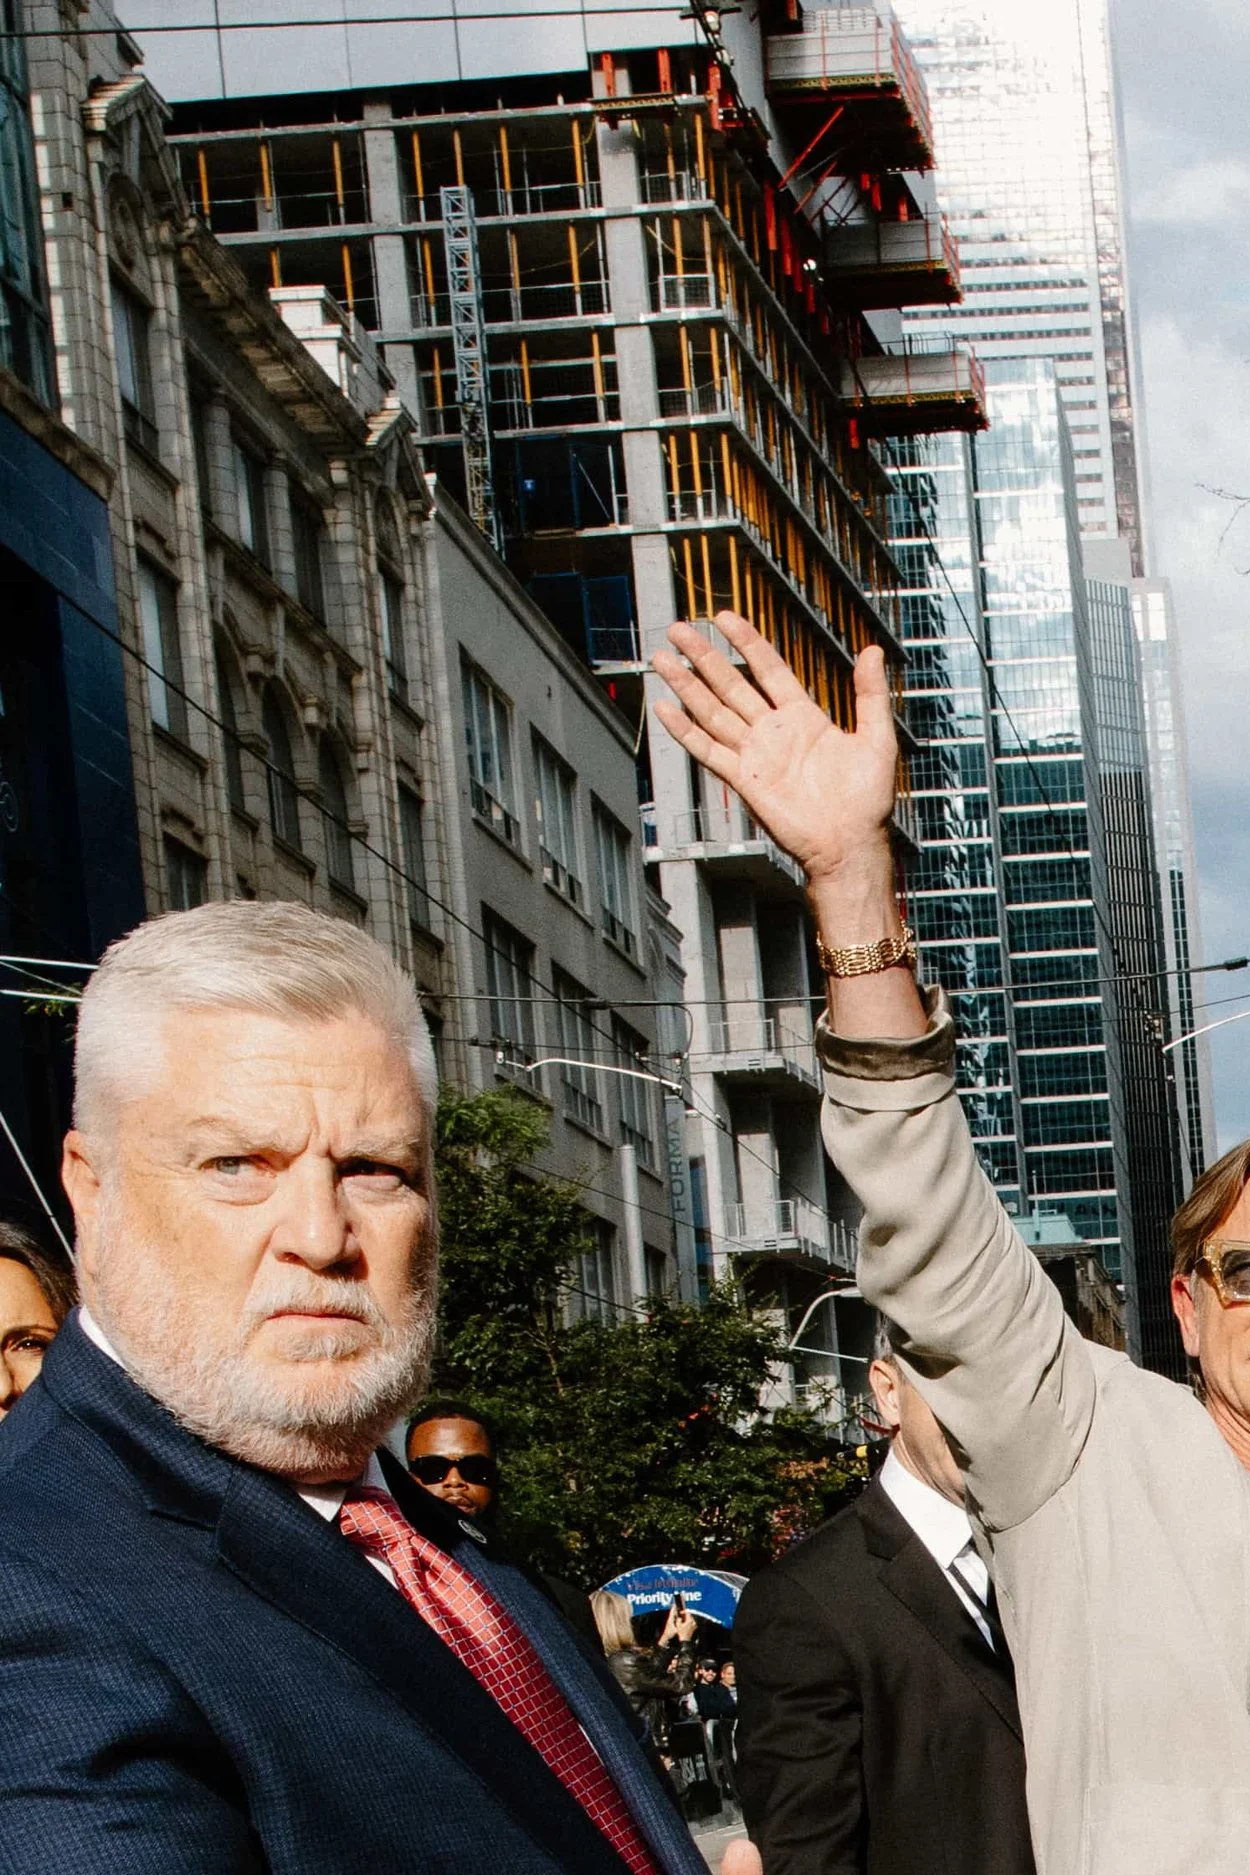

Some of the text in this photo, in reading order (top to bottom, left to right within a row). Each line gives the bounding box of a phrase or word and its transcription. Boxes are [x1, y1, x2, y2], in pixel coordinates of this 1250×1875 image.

[668, 1117, 685, 1213] FORMA
[627, 1590, 702, 1606] Priority ine
